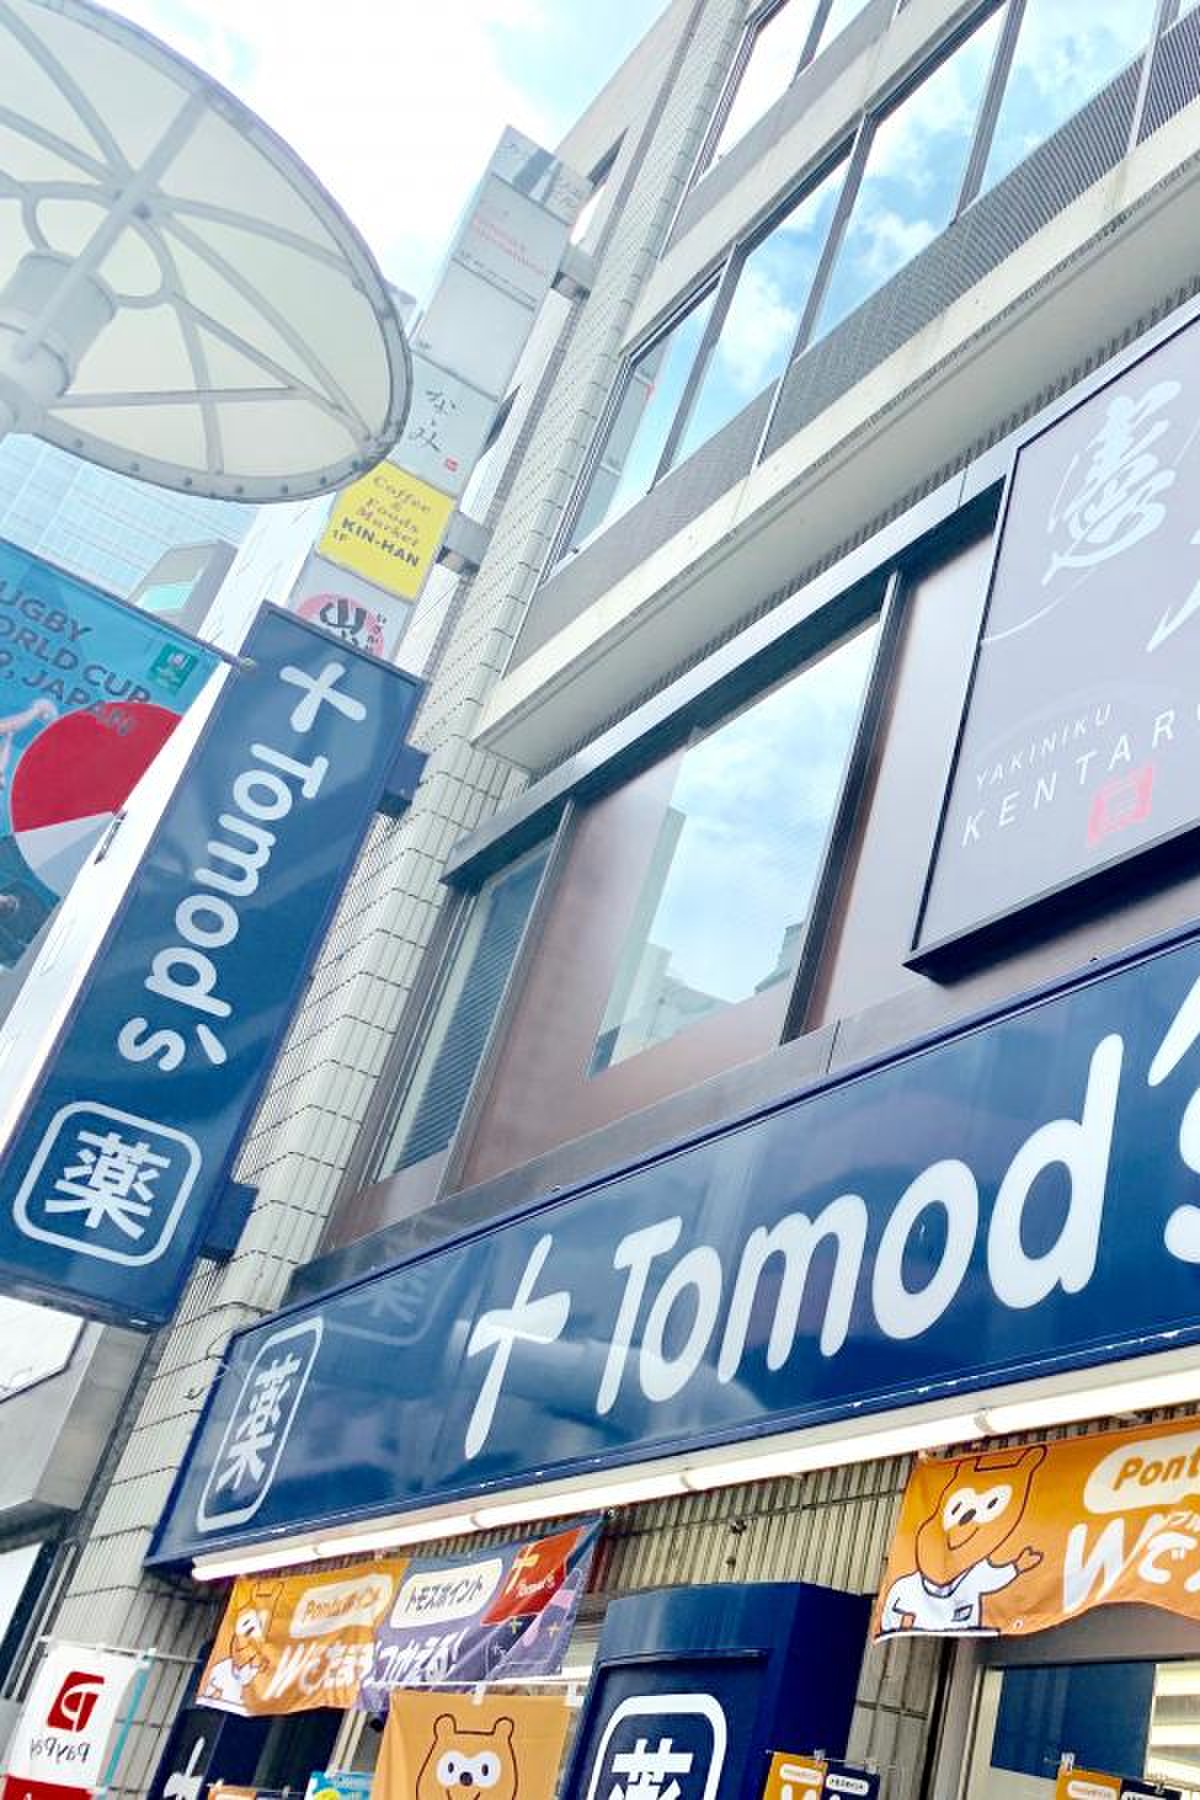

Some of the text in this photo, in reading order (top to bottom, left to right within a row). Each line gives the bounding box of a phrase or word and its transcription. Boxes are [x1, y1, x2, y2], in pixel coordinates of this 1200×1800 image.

[0, 580, 93, 642] UGBY
[0, 614, 79, 671] ORLD
[976, 703, 1111, 788] YAKINIKU
[118, 743, 331, 1071] Tomod's
[45, 1129, 171, 1241] 薬
[216, 1353, 304, 1492] 薬
